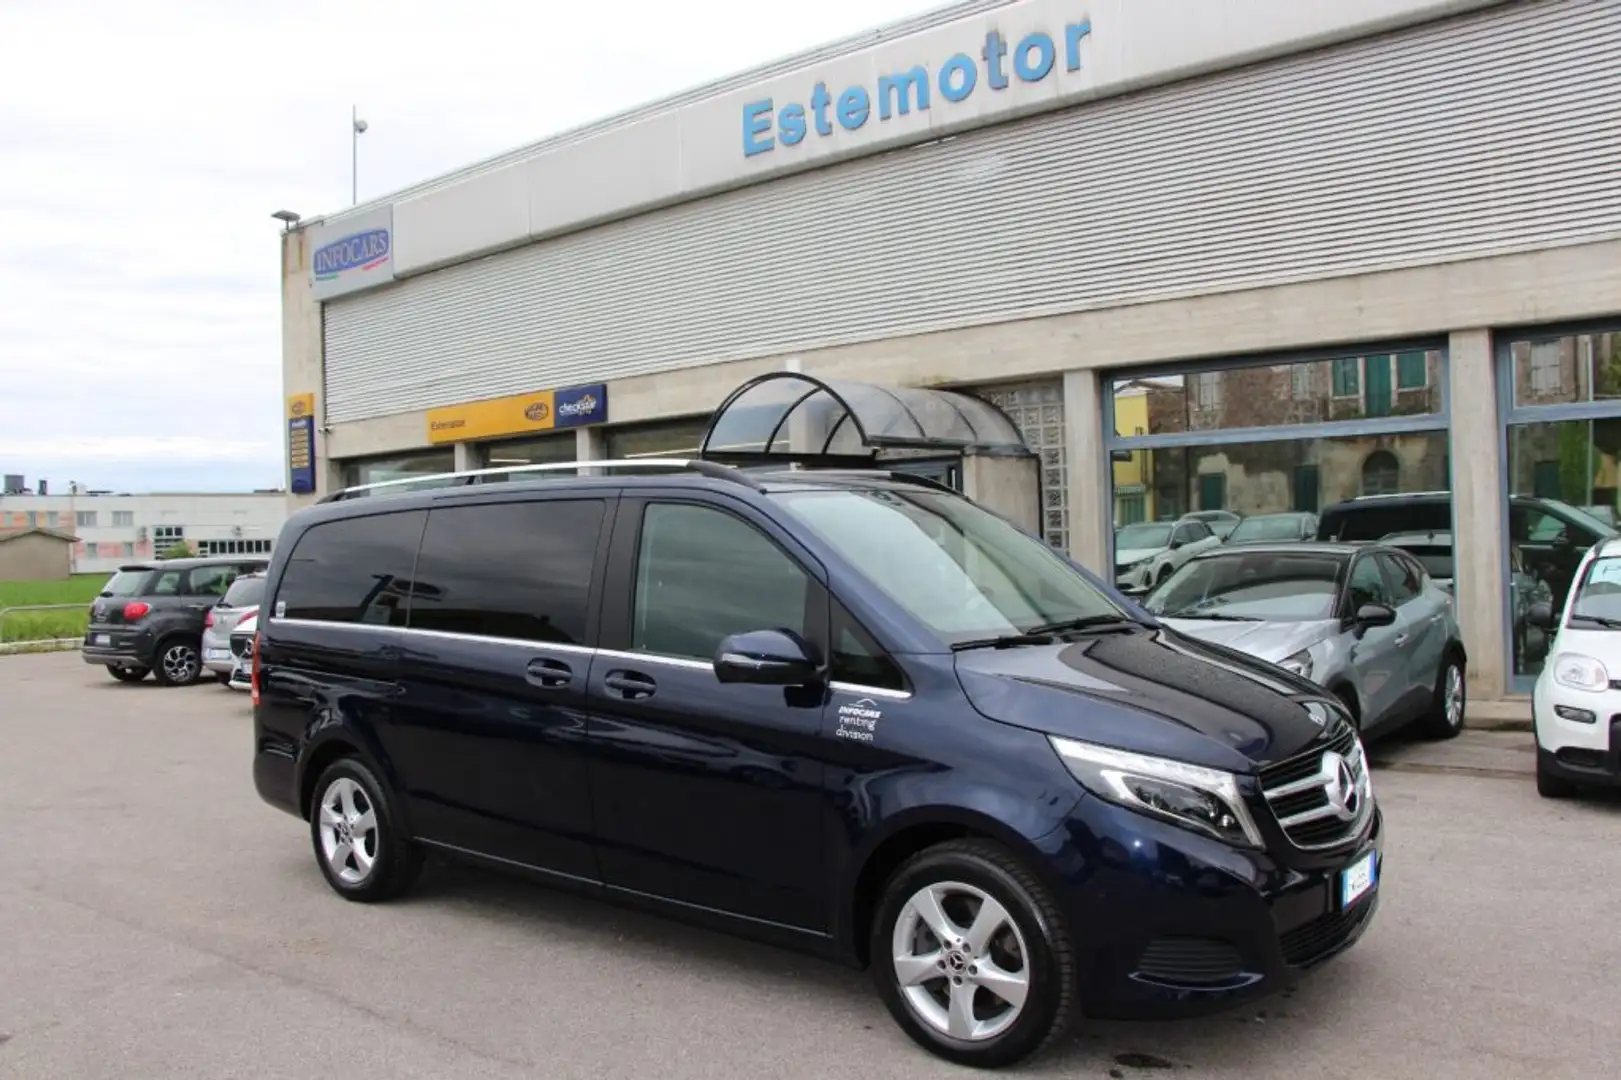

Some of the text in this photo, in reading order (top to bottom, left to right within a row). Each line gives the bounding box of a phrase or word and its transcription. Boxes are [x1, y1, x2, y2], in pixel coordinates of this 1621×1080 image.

[743, 19, 1092, 158] Estemotor
[316, 233, 387, 272] INFOCARS
[836, 724, 874, 741] division
[839, 715, 876, 731] renting
